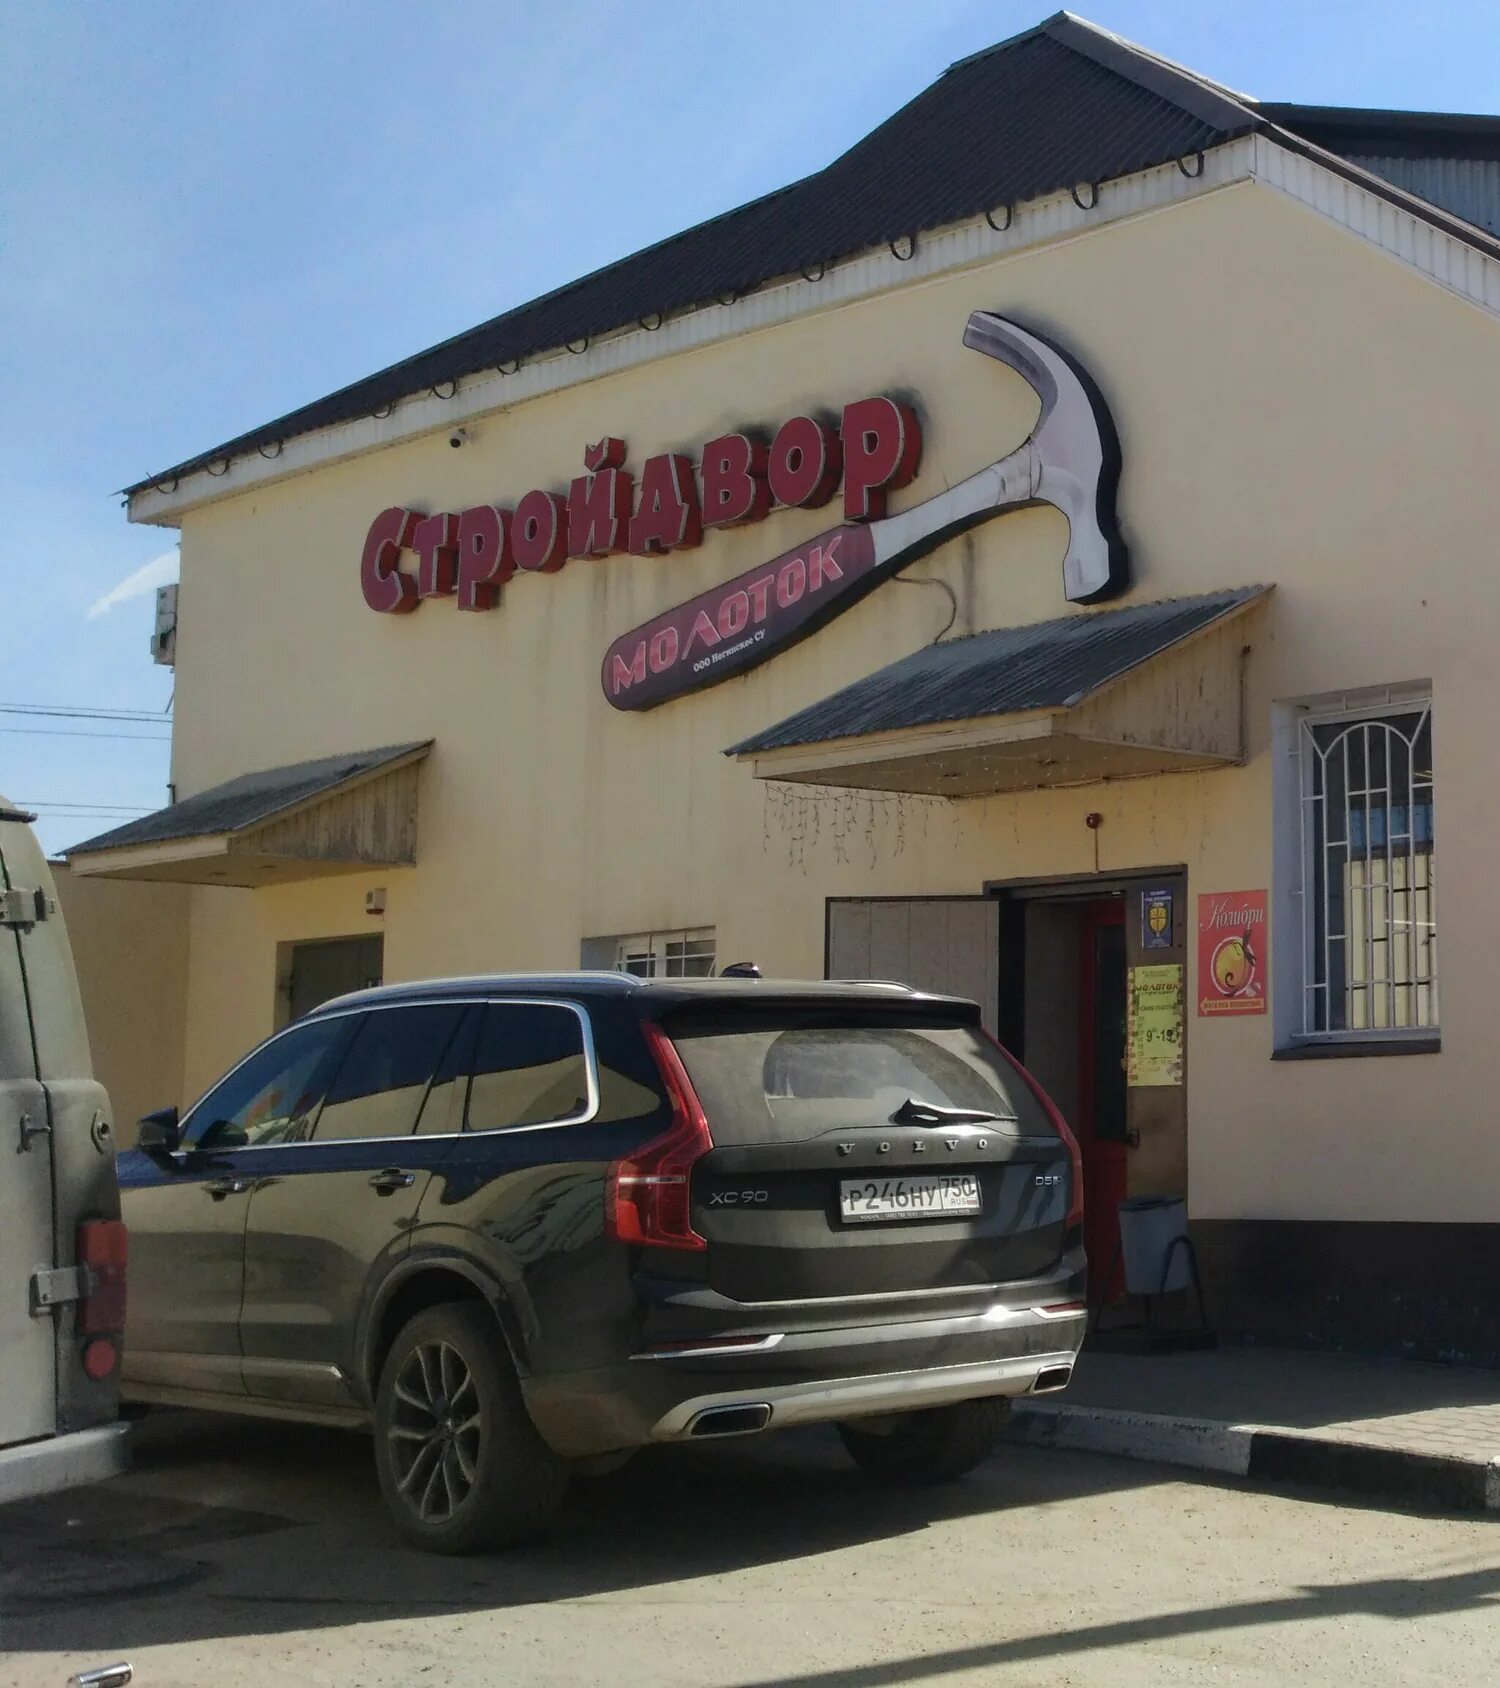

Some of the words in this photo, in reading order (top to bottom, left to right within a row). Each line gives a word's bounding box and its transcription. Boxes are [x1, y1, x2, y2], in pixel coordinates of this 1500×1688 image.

[612, 536, 845, 696] МОЛОТОК
[839, 1138, 987, 1154] VOLVO
[941, 1177, 973, 1198] 750
